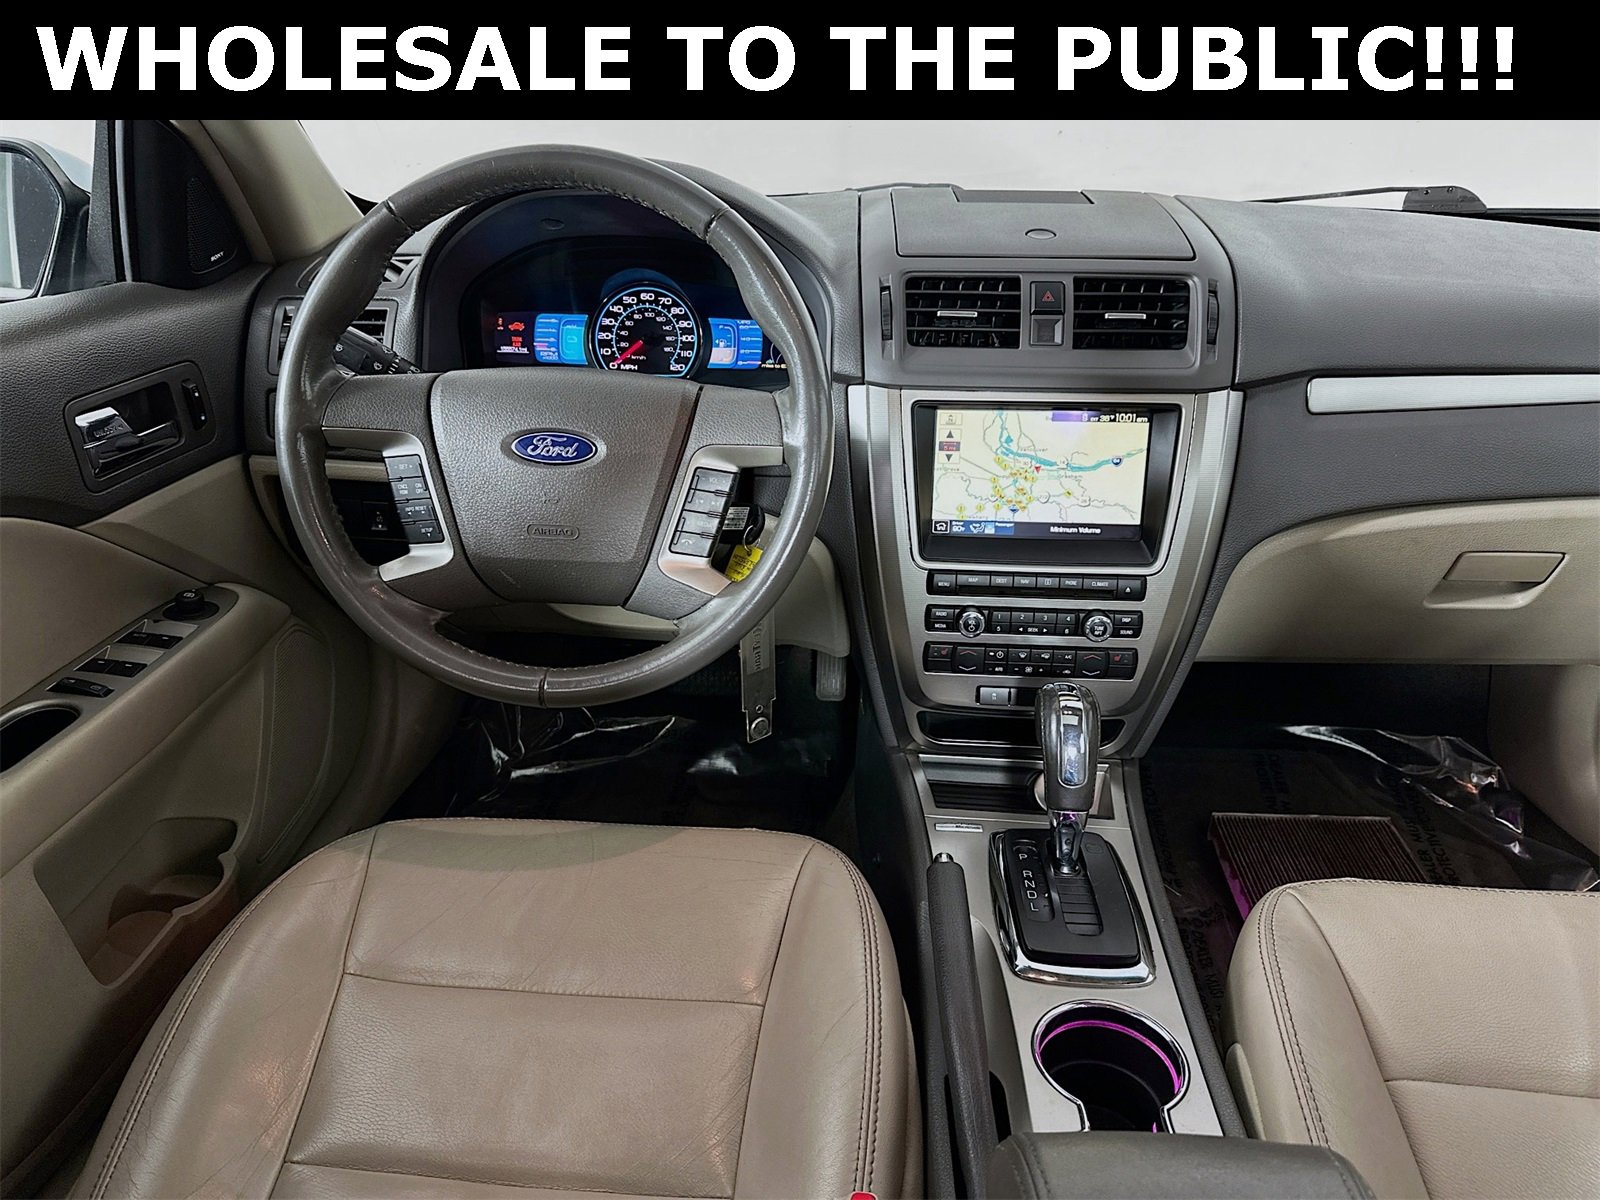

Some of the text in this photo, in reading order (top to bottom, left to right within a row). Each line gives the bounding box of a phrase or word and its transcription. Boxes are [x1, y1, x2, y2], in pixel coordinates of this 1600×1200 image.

[527, 436, 579, 457] Ford
[532, 527, 574, 536] AIRBAG
[1422, 825, 1461, 885] ROTECTIVE
[1416, 849, 1443, 883] EALER
[1030, 902, 1039, 911] L
